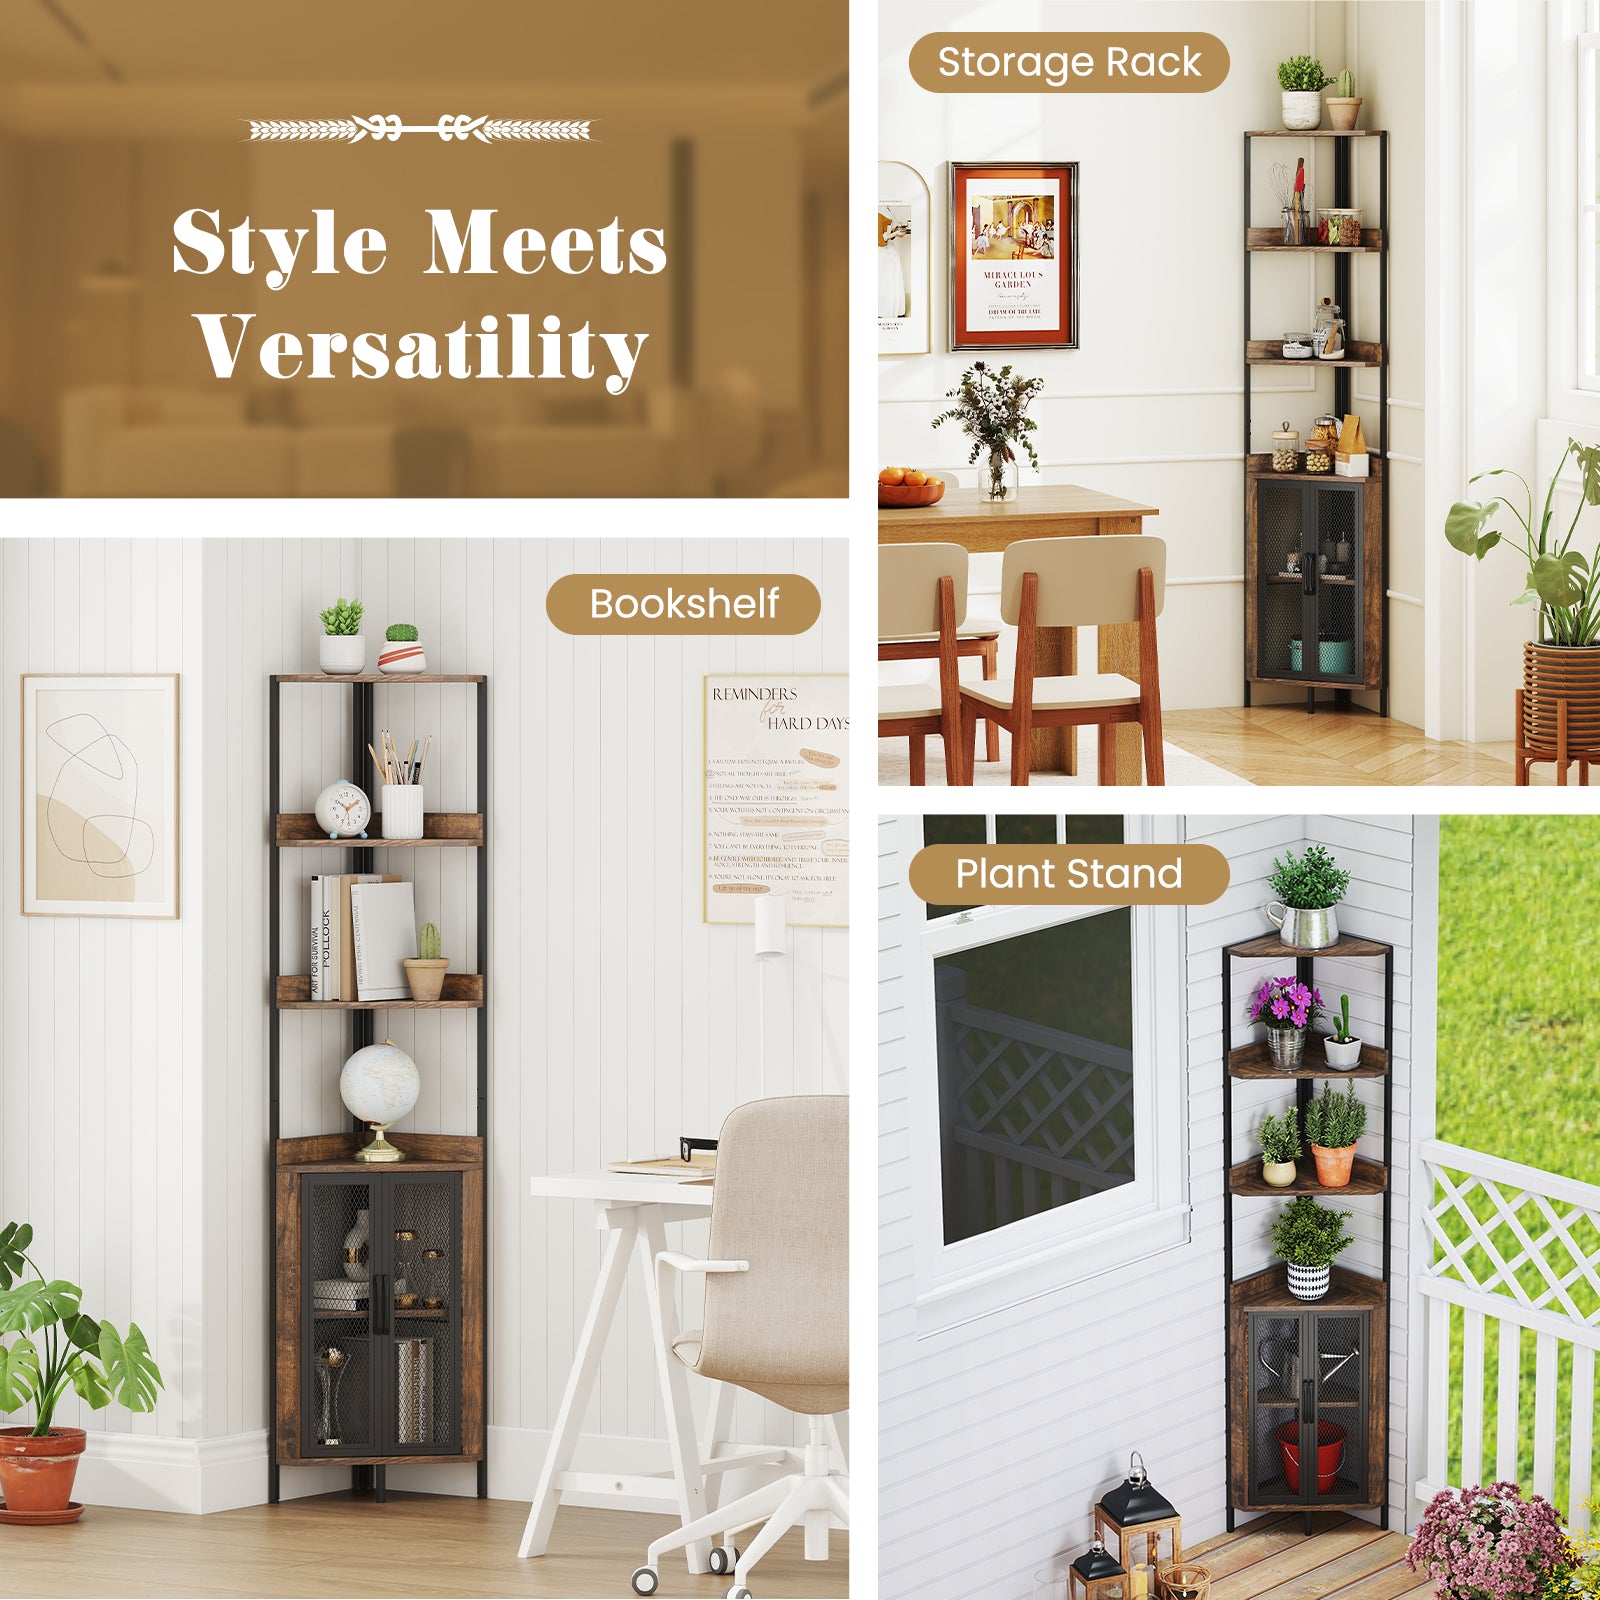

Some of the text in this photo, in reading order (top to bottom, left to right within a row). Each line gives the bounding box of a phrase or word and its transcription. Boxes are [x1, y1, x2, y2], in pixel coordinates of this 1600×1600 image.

[994, 280, 1032, 288] GARDEN
[713, 687, 798, 700] REMINDERS
[760, 699, 785, 723] for
[768, 717, 849, 729] HARD DAYS
[322, 909, 330, 968] POLLOCK
[311, 926, 319, 993] ART FOR SURVIVAL
